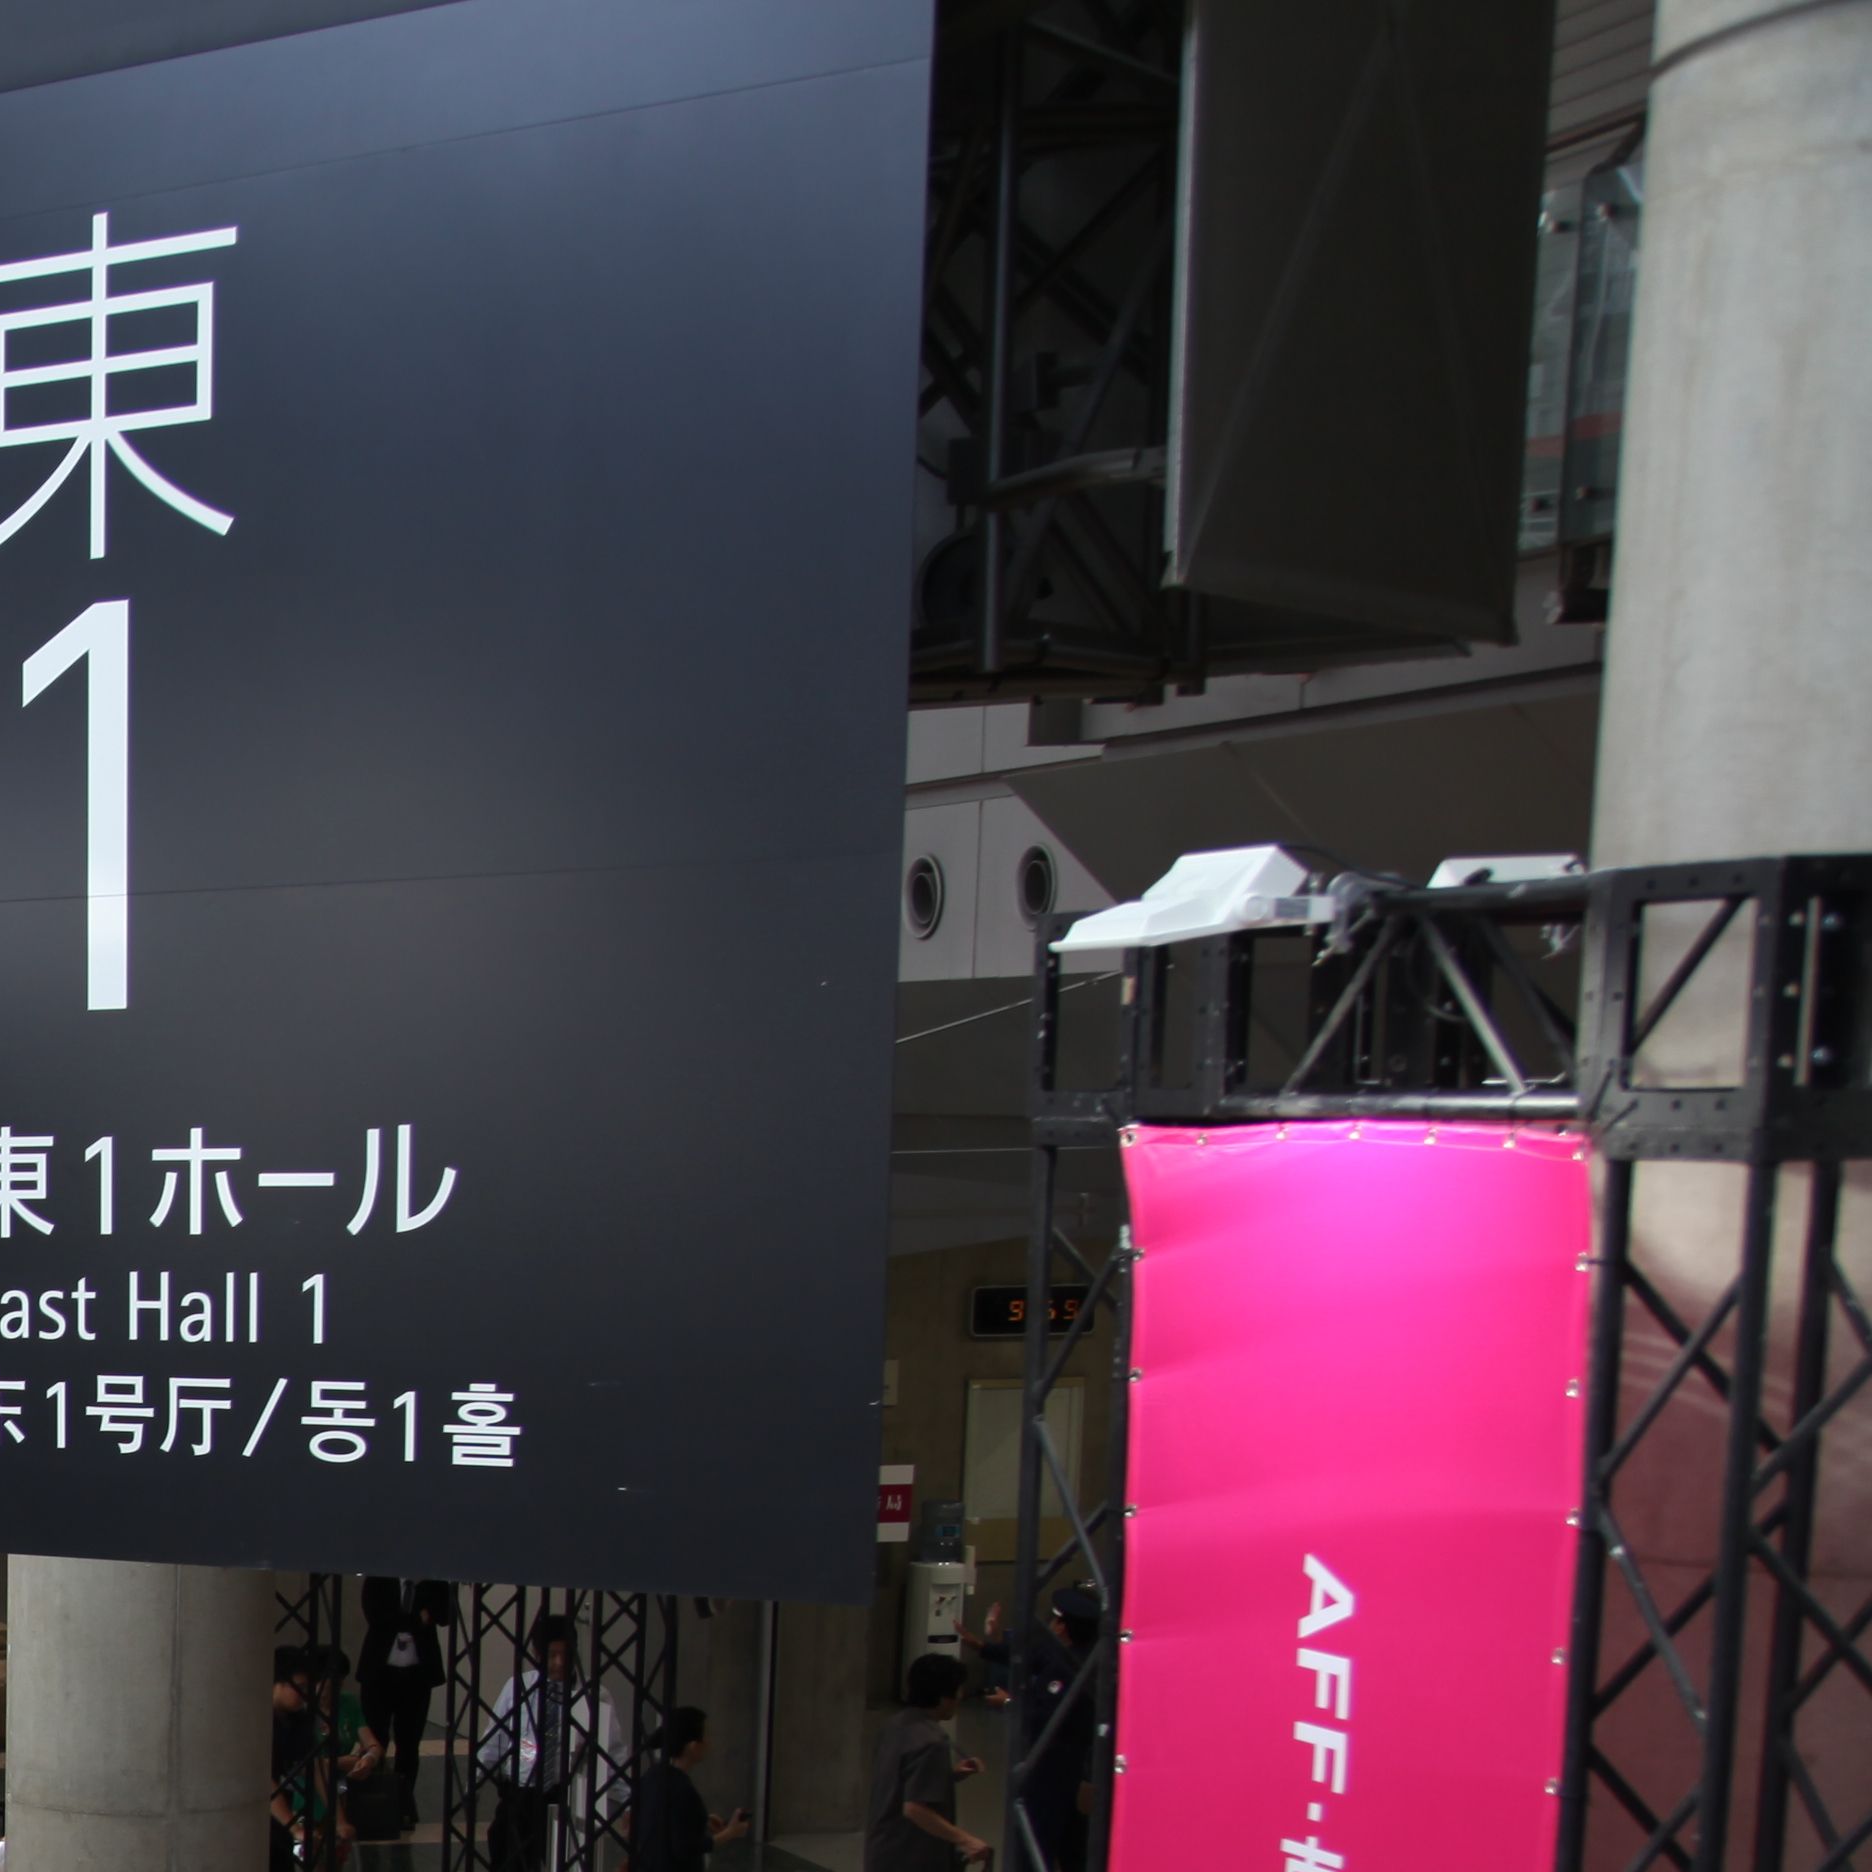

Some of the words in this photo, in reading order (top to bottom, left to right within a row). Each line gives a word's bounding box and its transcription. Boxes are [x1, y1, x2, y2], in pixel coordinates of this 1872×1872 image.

[22, 599, 129, 1010] 1
[129, 1271, 258, 1343] Hall
[302, 1273, 324, 1344] 1
